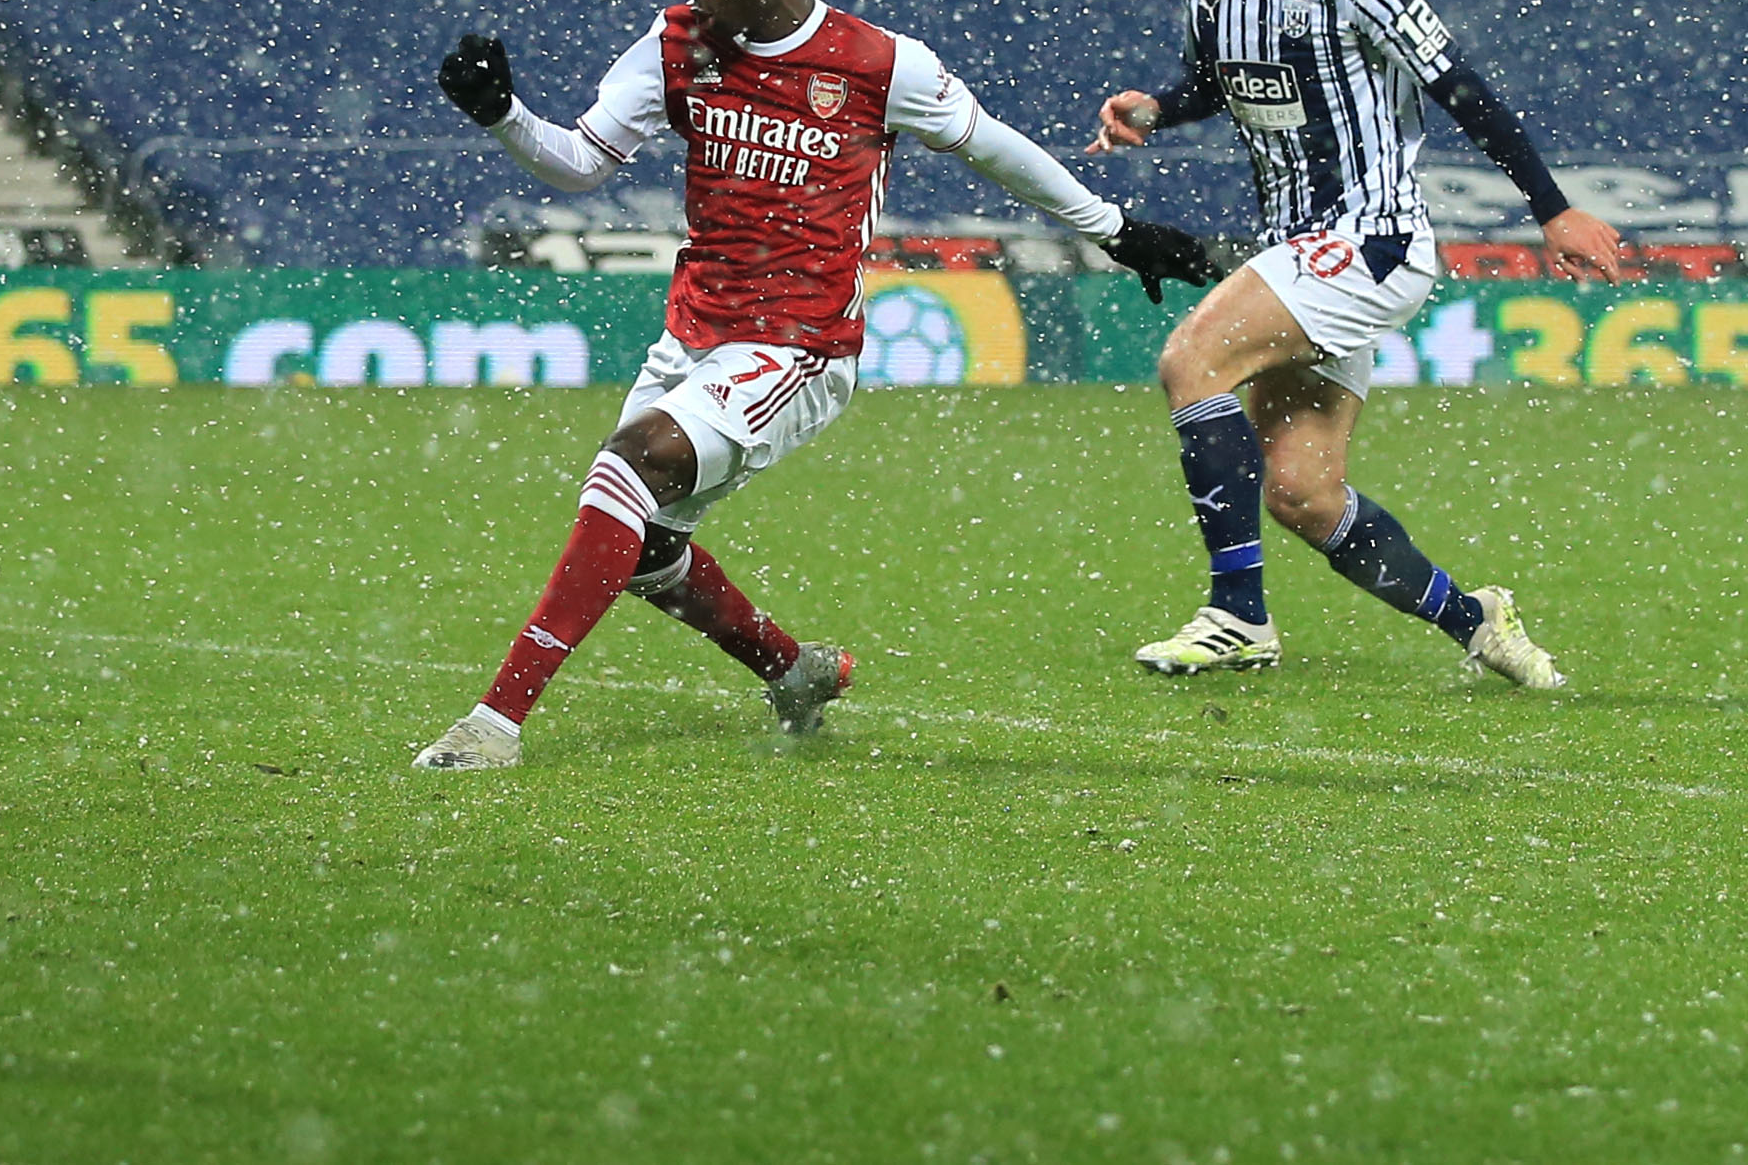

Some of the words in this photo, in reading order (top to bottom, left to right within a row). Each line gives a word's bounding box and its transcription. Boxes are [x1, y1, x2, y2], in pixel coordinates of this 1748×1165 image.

[1219, 64, 1293, 100] ideal
[686, 96, 840, 159] Emirates
[704, 140, 732, 172] FLY
[734, 148, 810, 186] BETTER
[1285, 229, 1354, 280] 20
[728, 350, 784, 386] 7
